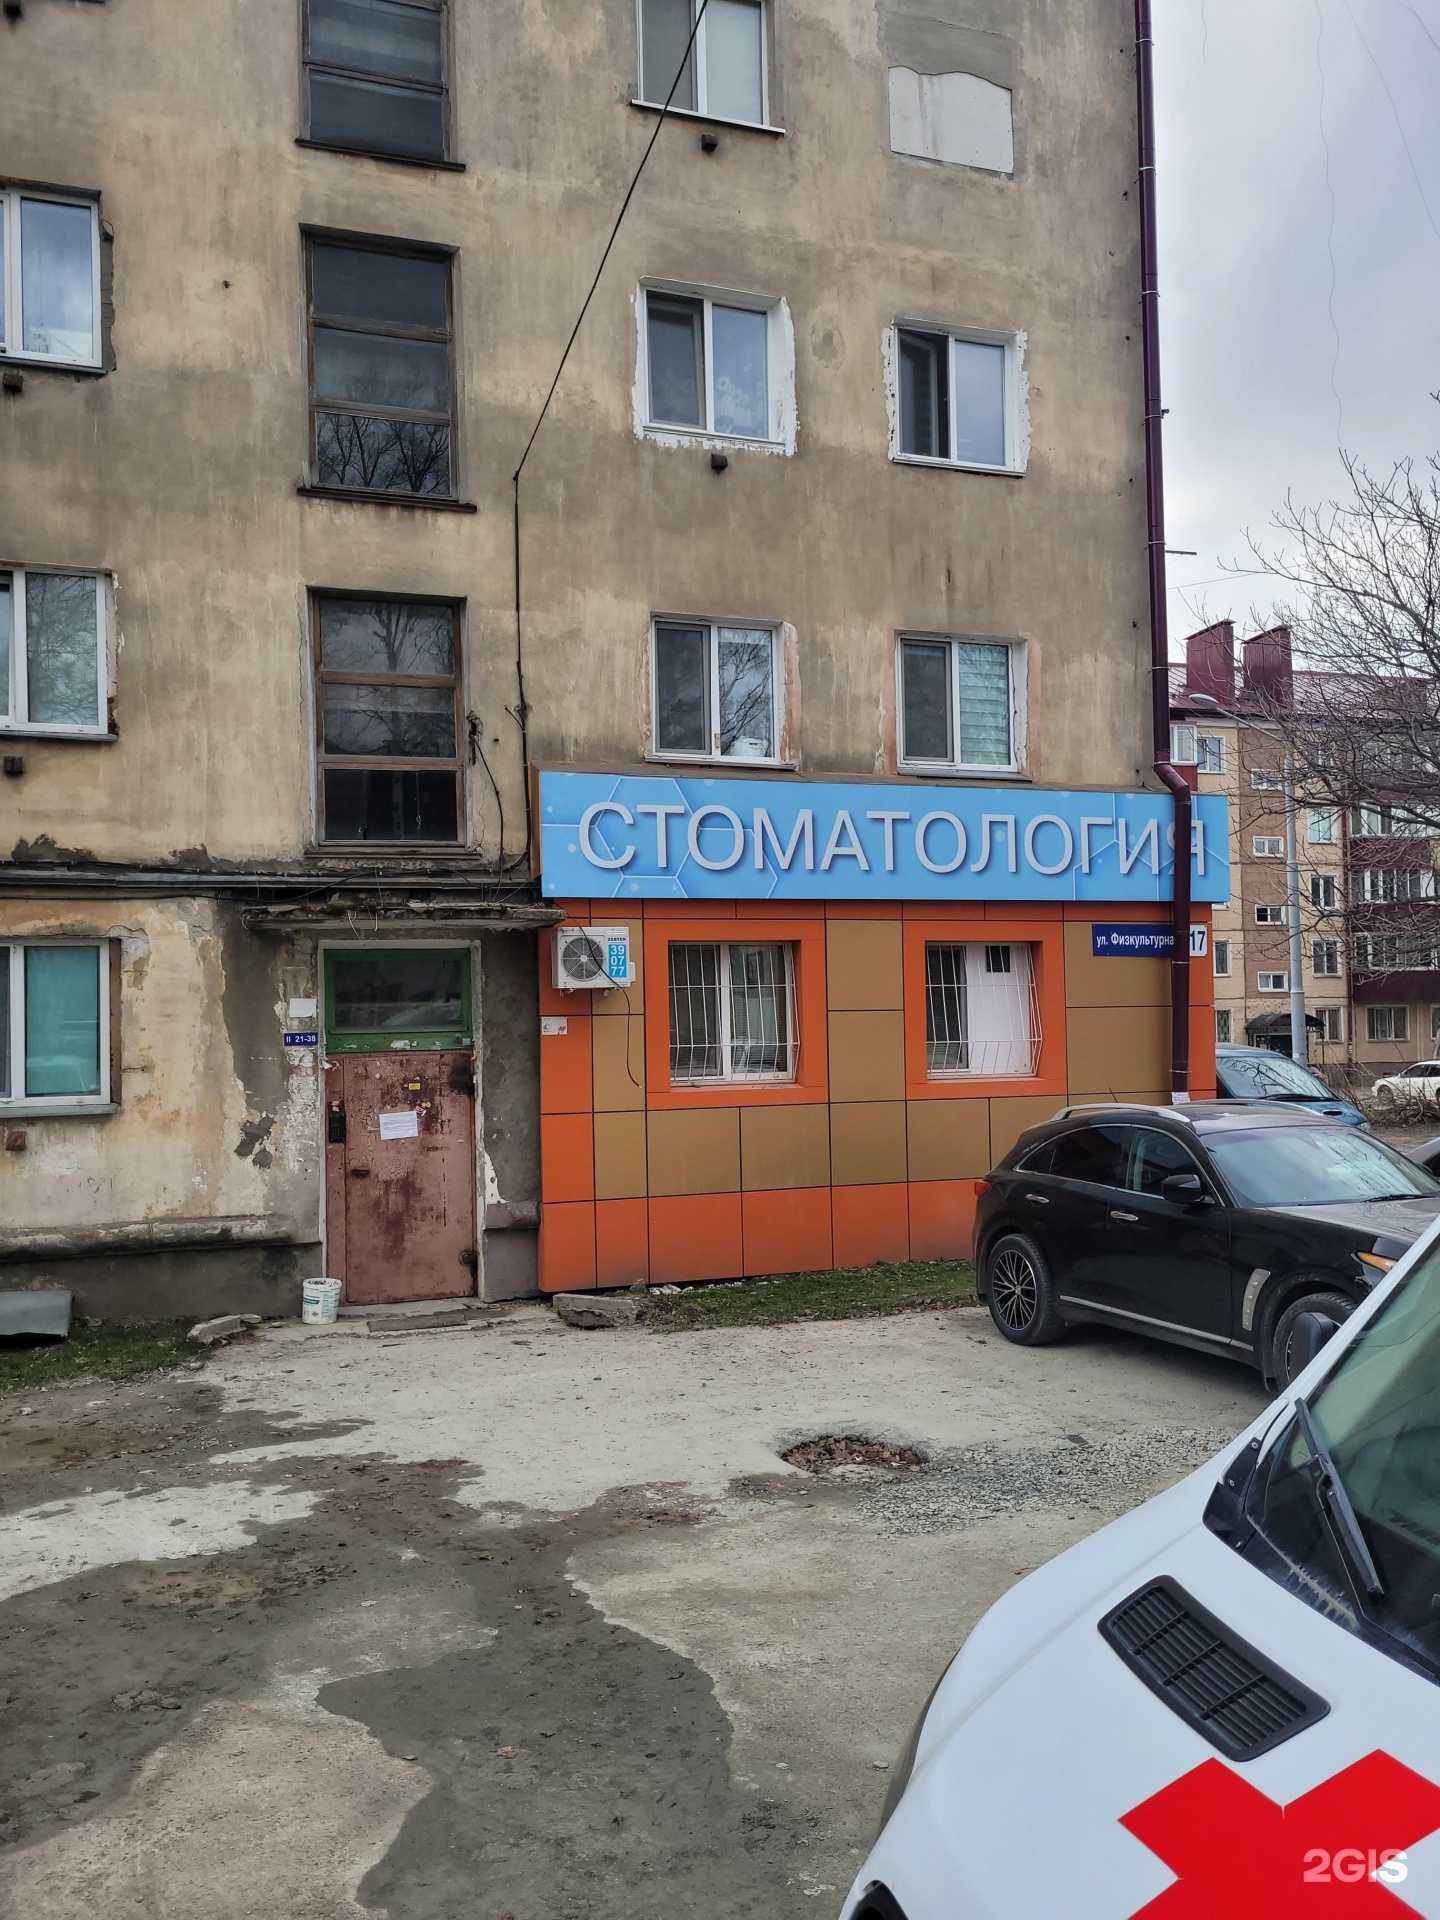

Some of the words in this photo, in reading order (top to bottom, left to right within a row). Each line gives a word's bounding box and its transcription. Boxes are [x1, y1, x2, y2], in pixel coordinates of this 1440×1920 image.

[579, 800, 1205, 877] СТОМАТОЛОГИЯ
[1096, 935, 1108, 948] ул.
[1110, 932, 1175, 948] Физкультурна
[1190, 930, 1206, 951] 17
[611, 945, 625, 955] 39
[611, 955, 625, 965] 07
[611, 966, 625, 976] 77
